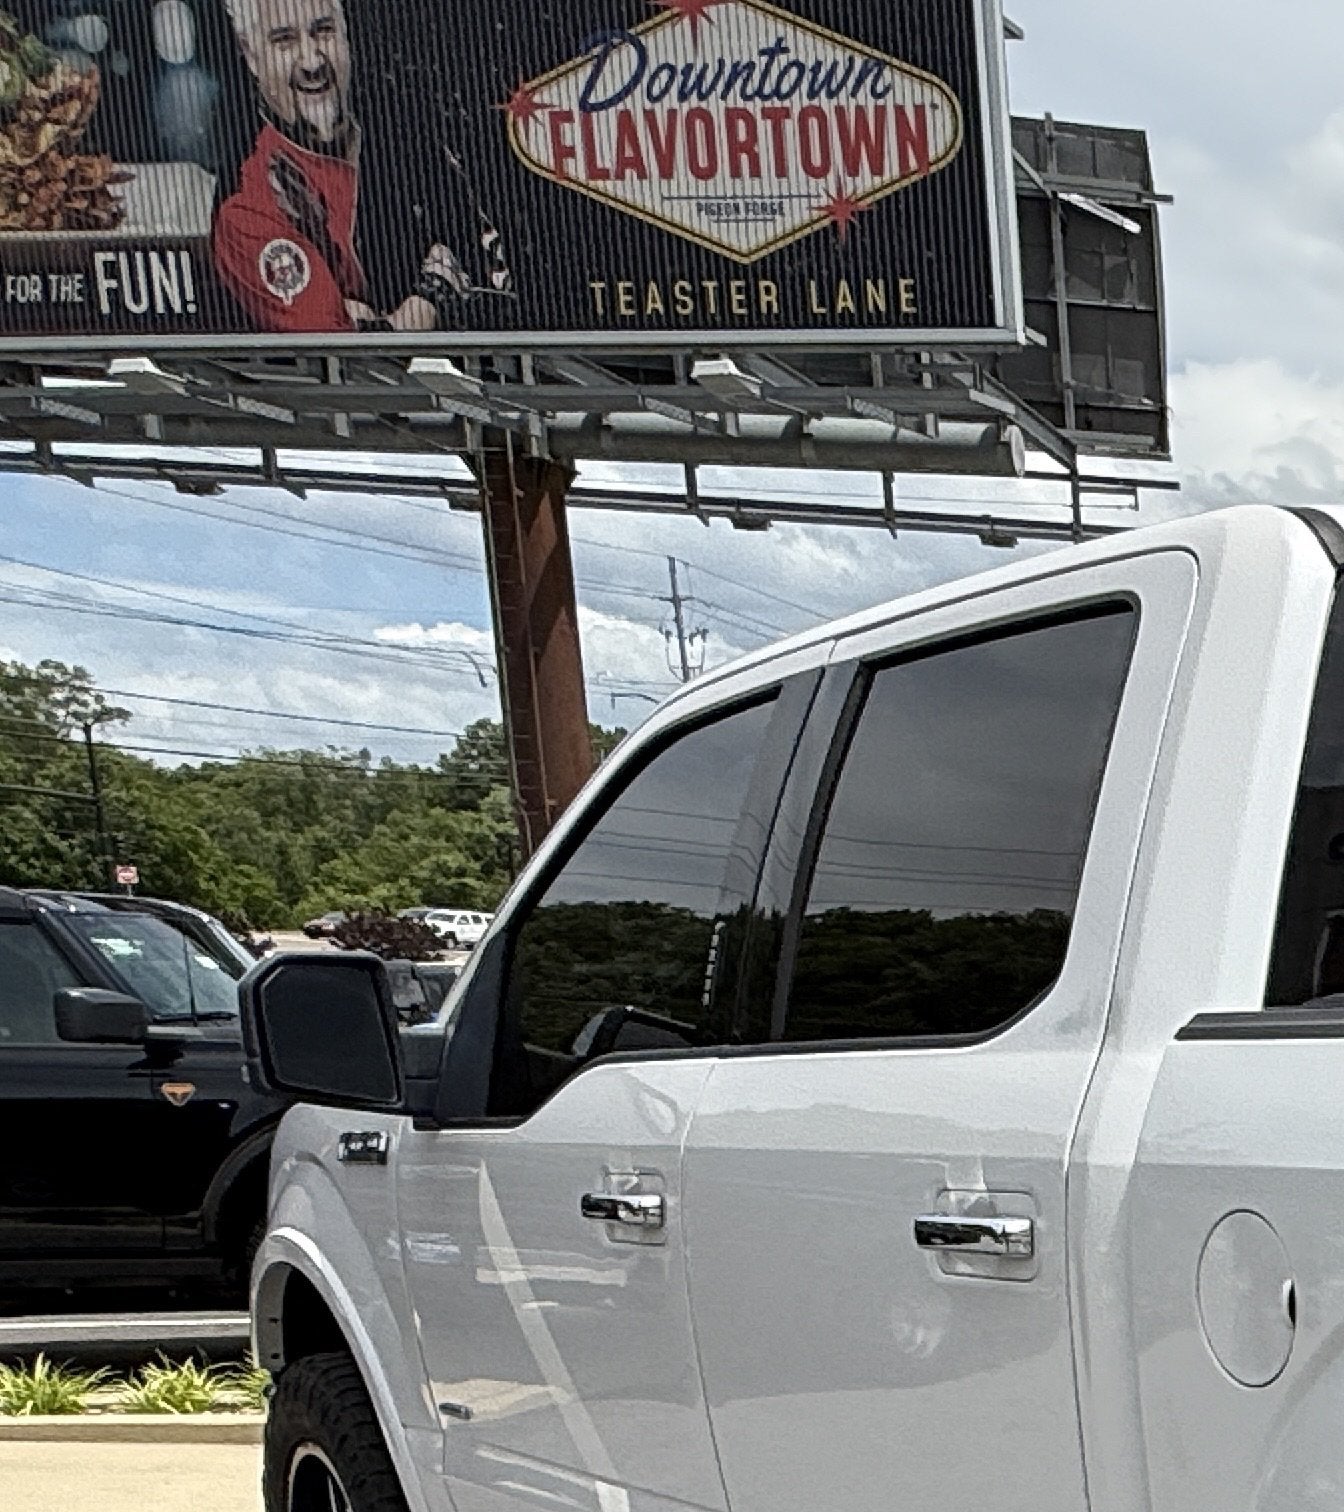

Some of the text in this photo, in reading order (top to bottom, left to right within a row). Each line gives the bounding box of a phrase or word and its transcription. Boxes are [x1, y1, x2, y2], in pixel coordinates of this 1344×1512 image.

[577, 28, 892, 112] Downtown
[547, 104, 931, 181] FLAVORTOWN
[6, 251, 198, 315] FOR THE FUN!
[589, 278, 918, 316] TEASTER LANE
